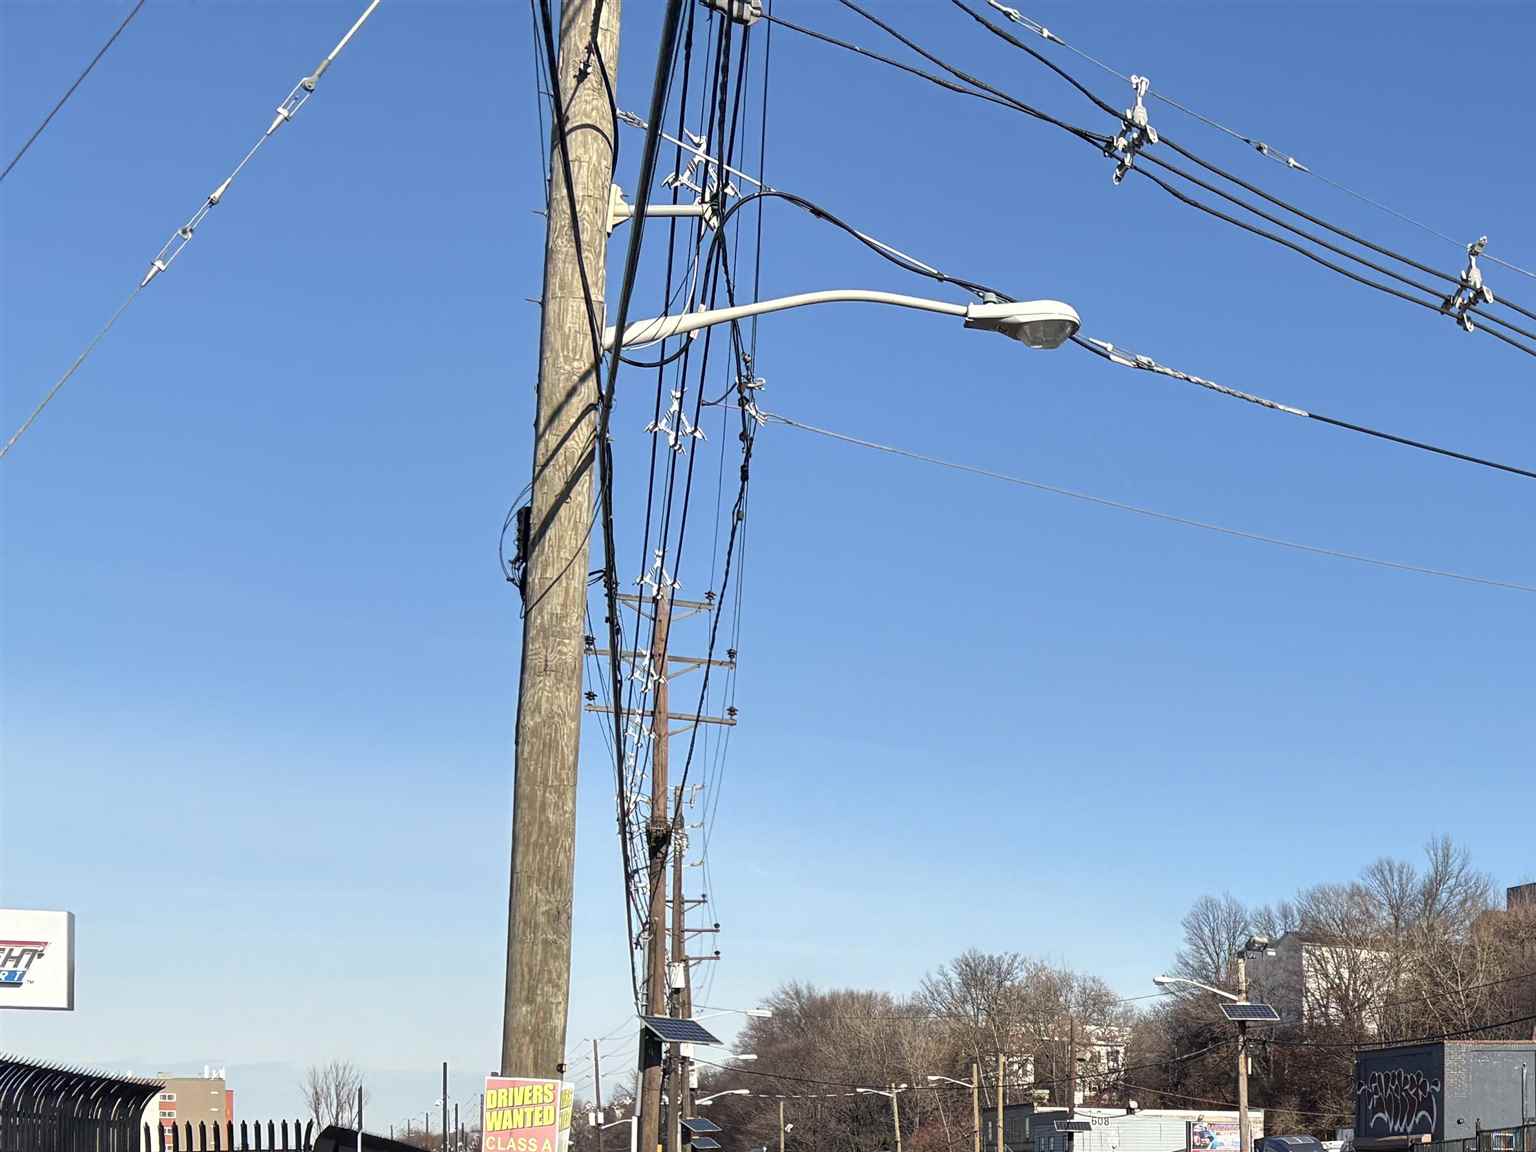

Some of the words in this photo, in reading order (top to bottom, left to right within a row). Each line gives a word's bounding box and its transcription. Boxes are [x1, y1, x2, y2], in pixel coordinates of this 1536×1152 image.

[0, 947, 45, 969] HT
[486, 1083, 555, 1110] DRIVERS
[486, 1105, 556, 1132] WANTED
[486, 1136, 538, 1152] CLASS
[542, 1138, 552, 1152] A
